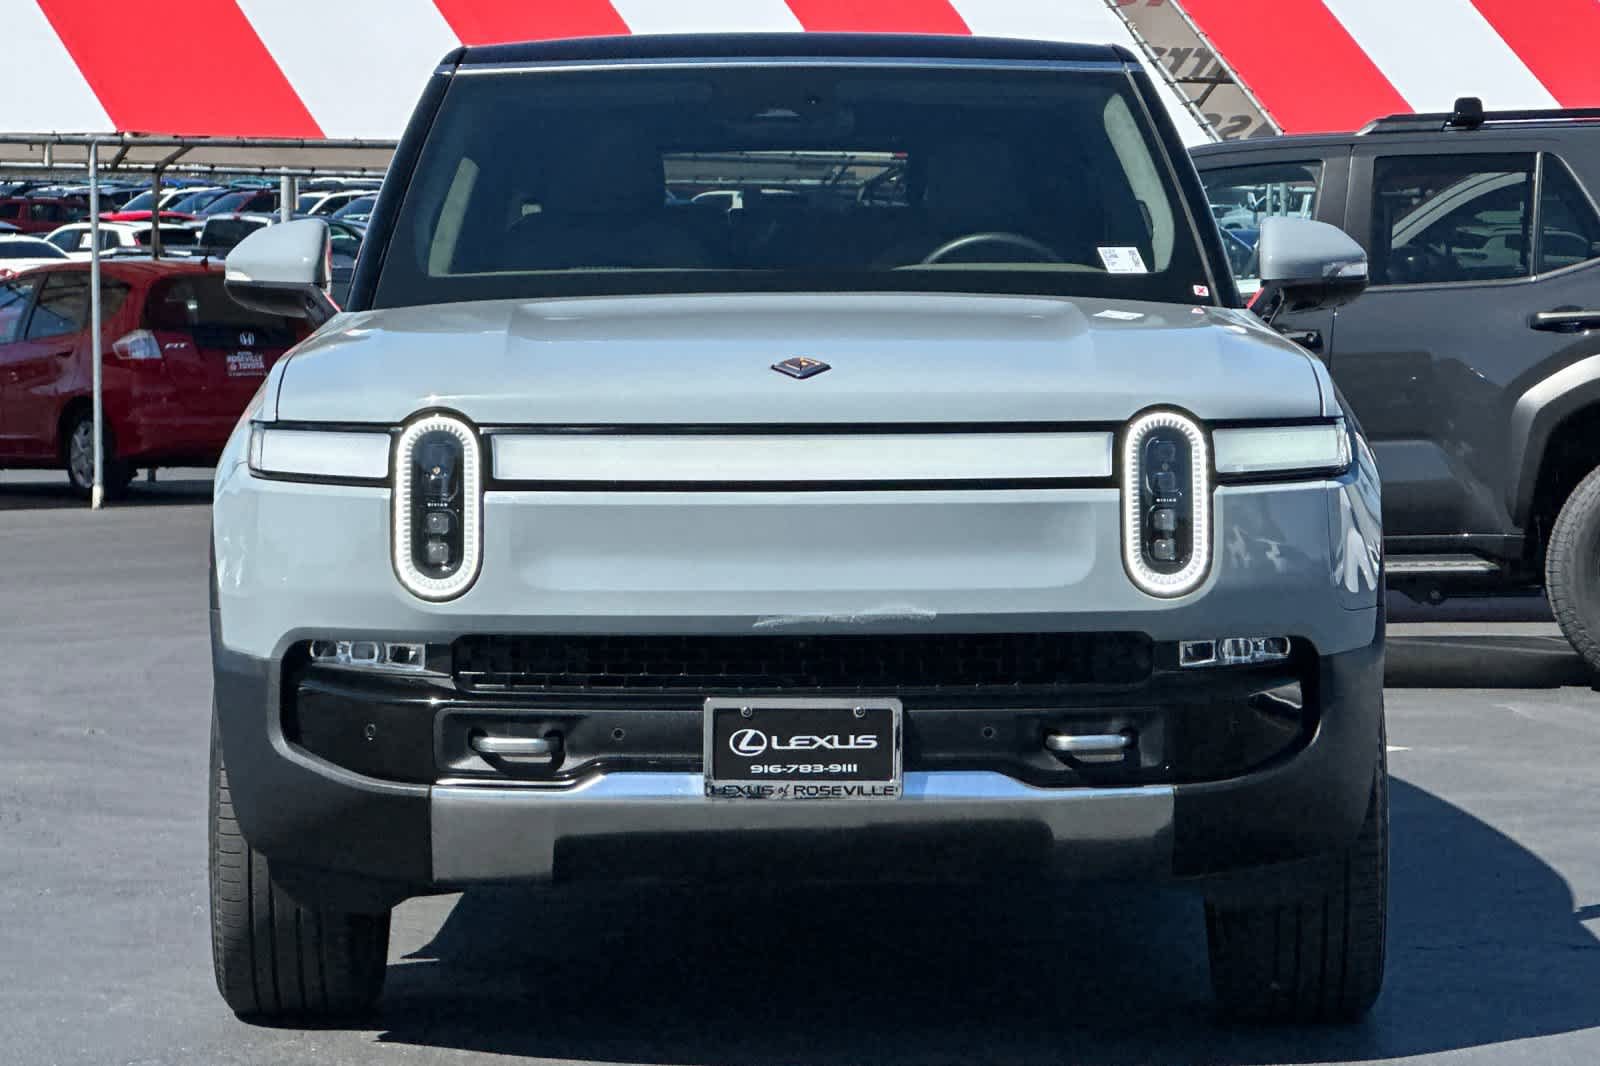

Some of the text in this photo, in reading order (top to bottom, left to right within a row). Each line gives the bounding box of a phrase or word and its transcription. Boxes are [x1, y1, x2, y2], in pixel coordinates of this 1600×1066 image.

[771, 735, 878, 750] LEXUS
[750, 763, 858, 774] 916-783-9111
[793, 785, 895, 796] ROSEVILLE
